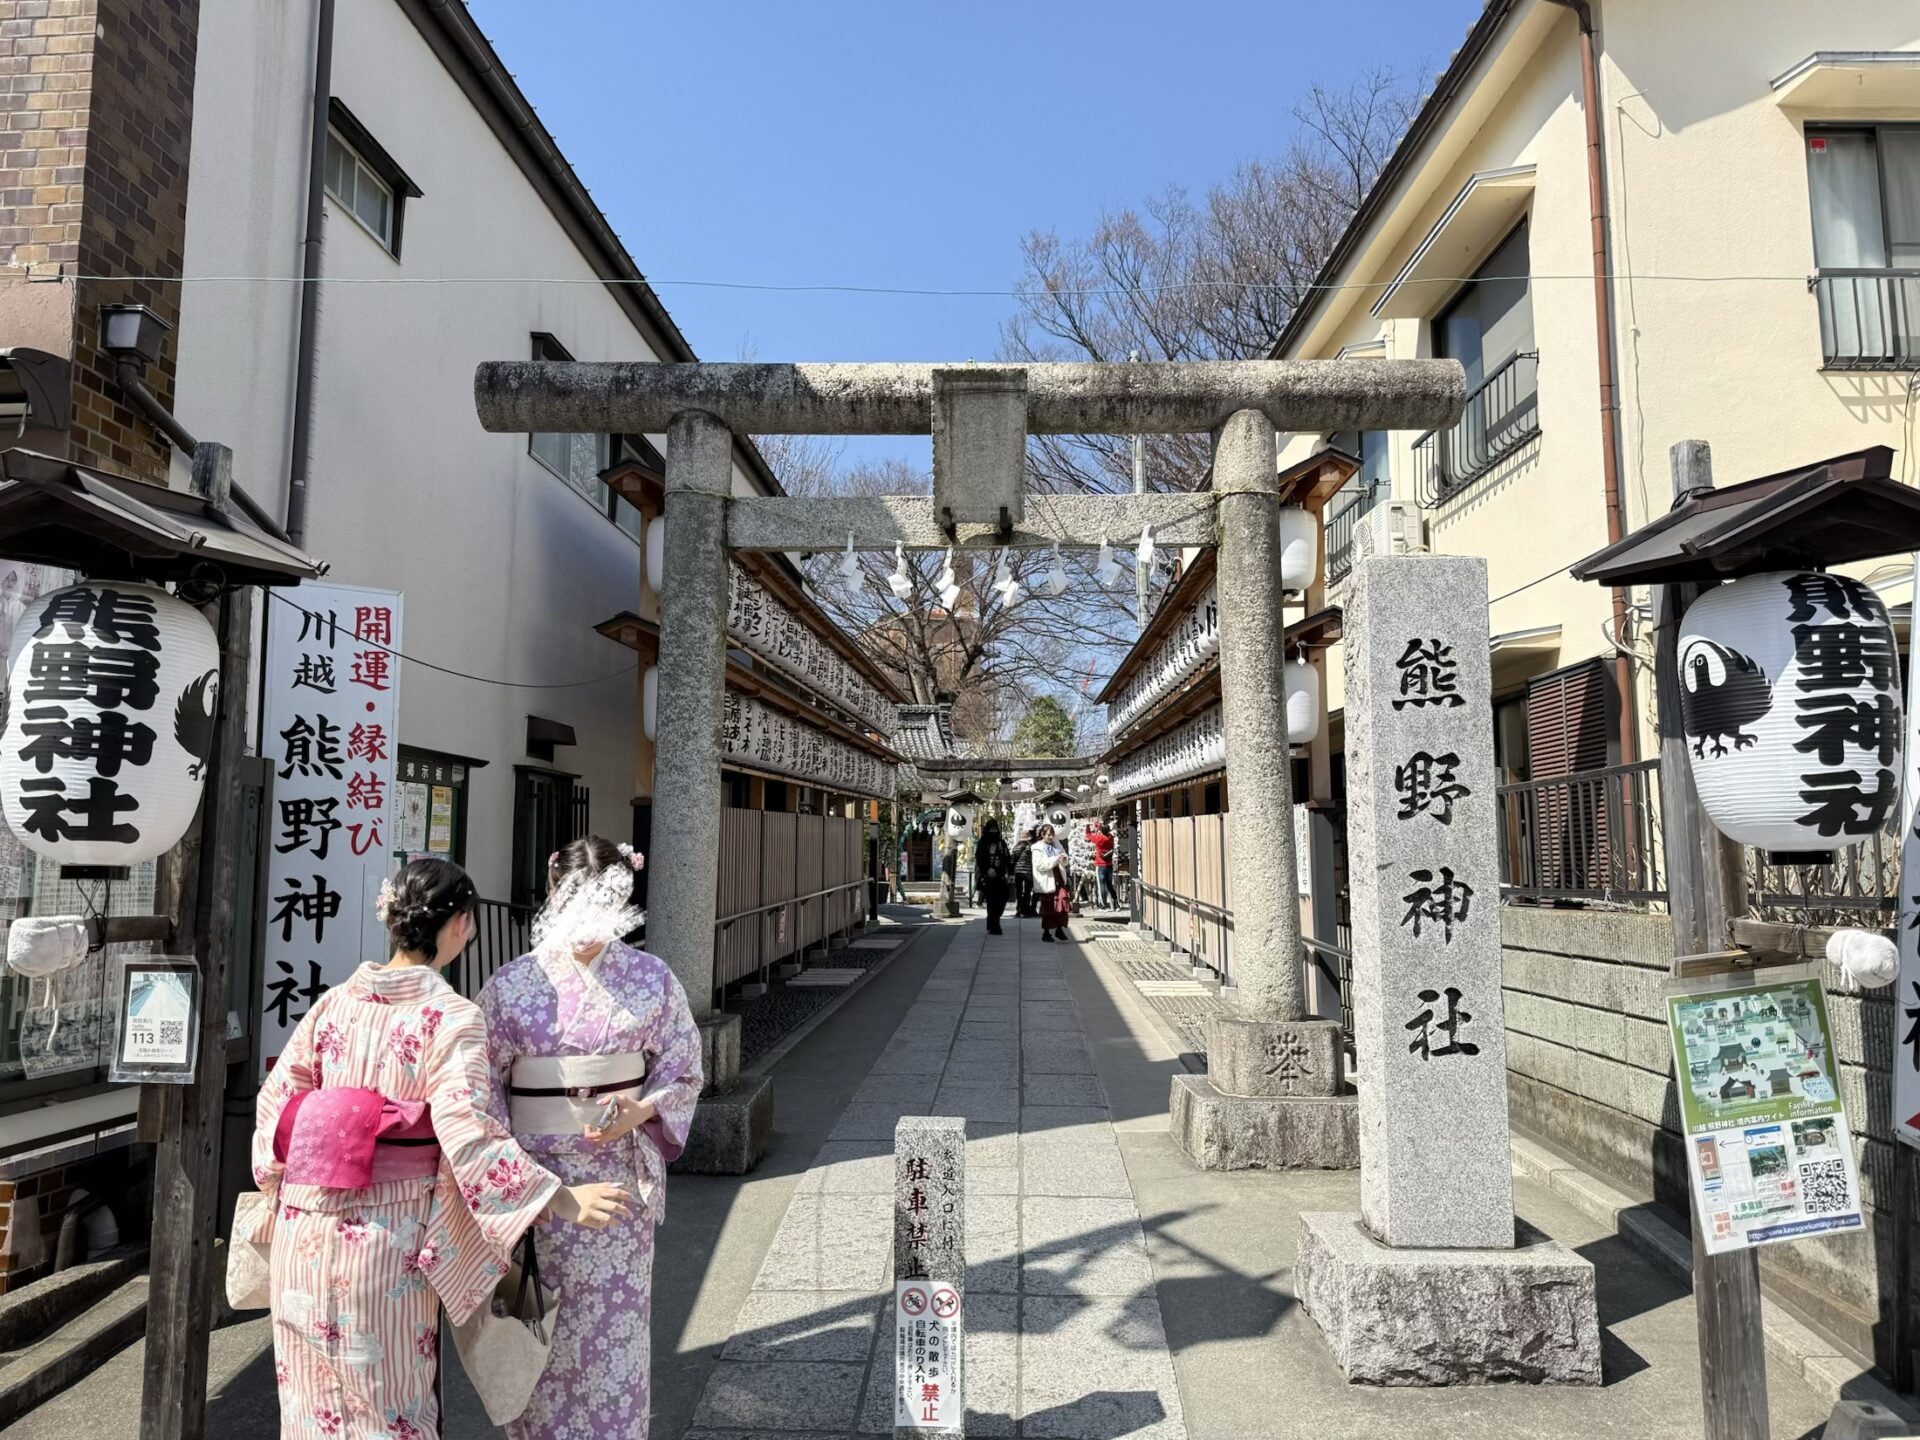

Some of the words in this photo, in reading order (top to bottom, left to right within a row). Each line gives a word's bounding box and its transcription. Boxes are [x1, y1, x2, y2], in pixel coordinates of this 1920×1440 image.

[291, 609, 338, 694] 川越
[19, 587, 163, 845] 熊野神社
[347, 606, 392, 856] 開運・縁結び
[397, 762, 443, 781] 掲示板
[263, 713, 346, 1028] 熊野神社
[1391, 638, 1480, 1062] 熊野神社
[132, 1032, 154, 1044] 113
[1788, 1101, 1815, 1110] Facility
[1790, 1106, 1833, 1118] information
[904, 1157, 930, 1279] 駐車禁止
[915, 1320, 926, 1383] 自転車のり入れ
[929, 1320, 940, 1378] 犬の散歩
[921, 1383, 939, 1421] 禁止
